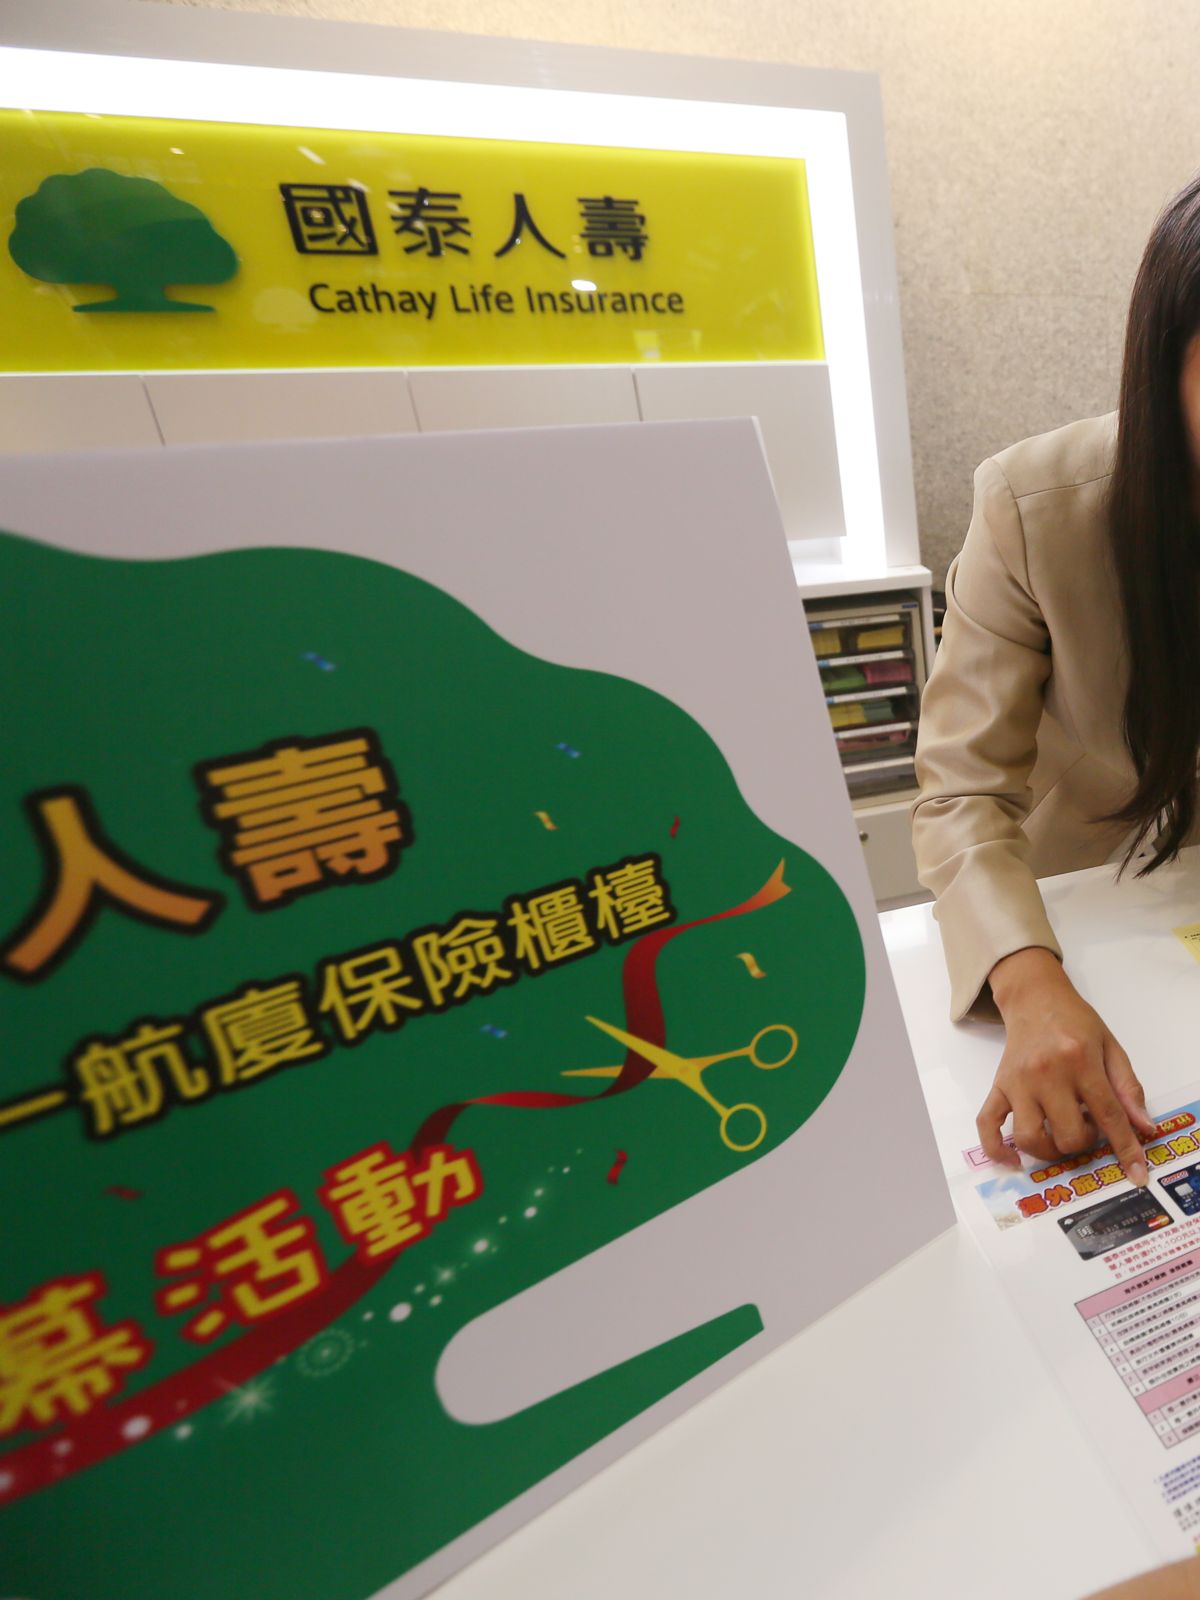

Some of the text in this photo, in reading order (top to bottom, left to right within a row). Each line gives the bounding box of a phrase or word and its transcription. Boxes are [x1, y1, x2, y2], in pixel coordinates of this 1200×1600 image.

[279, 182, 649, 262] 國泰人壽
[308, 283, 685, 320] Cathay Life Insurance
[2, 730, 410, 982] 人壽
